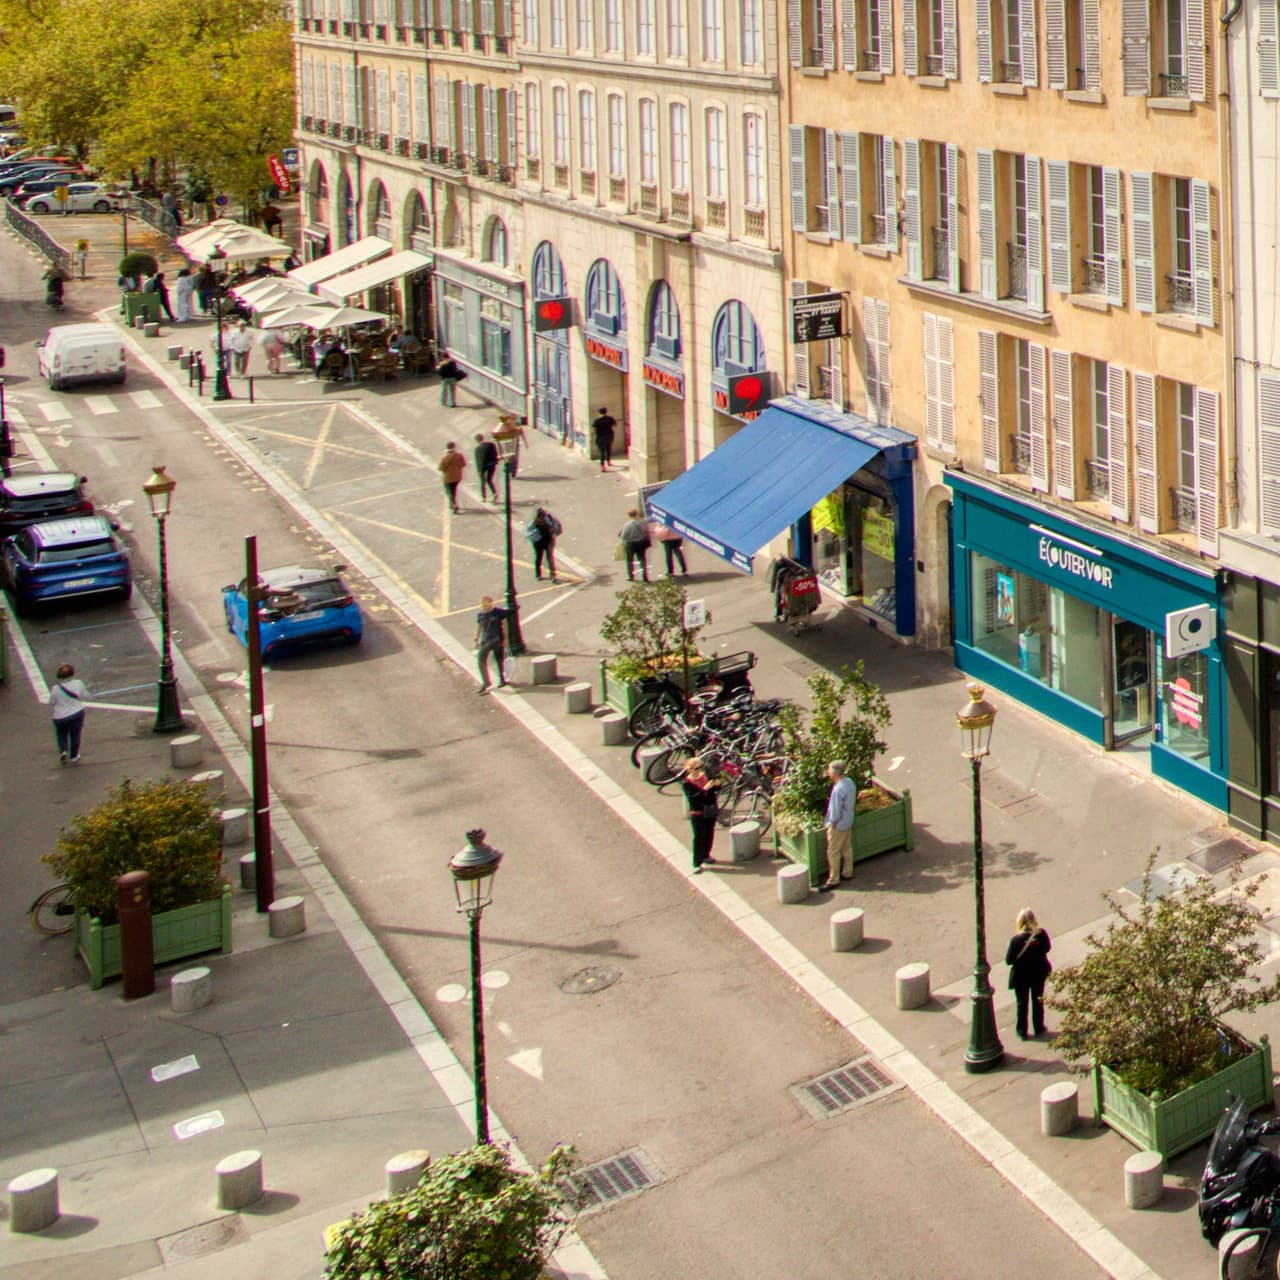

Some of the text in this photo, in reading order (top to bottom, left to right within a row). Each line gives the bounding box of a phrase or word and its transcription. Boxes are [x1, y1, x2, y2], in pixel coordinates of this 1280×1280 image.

[586, 338, 623, 367] MONOPRIX
[643, 364, 681, 394] MONOPRIX
[795, 580, 815, 592] -50%
